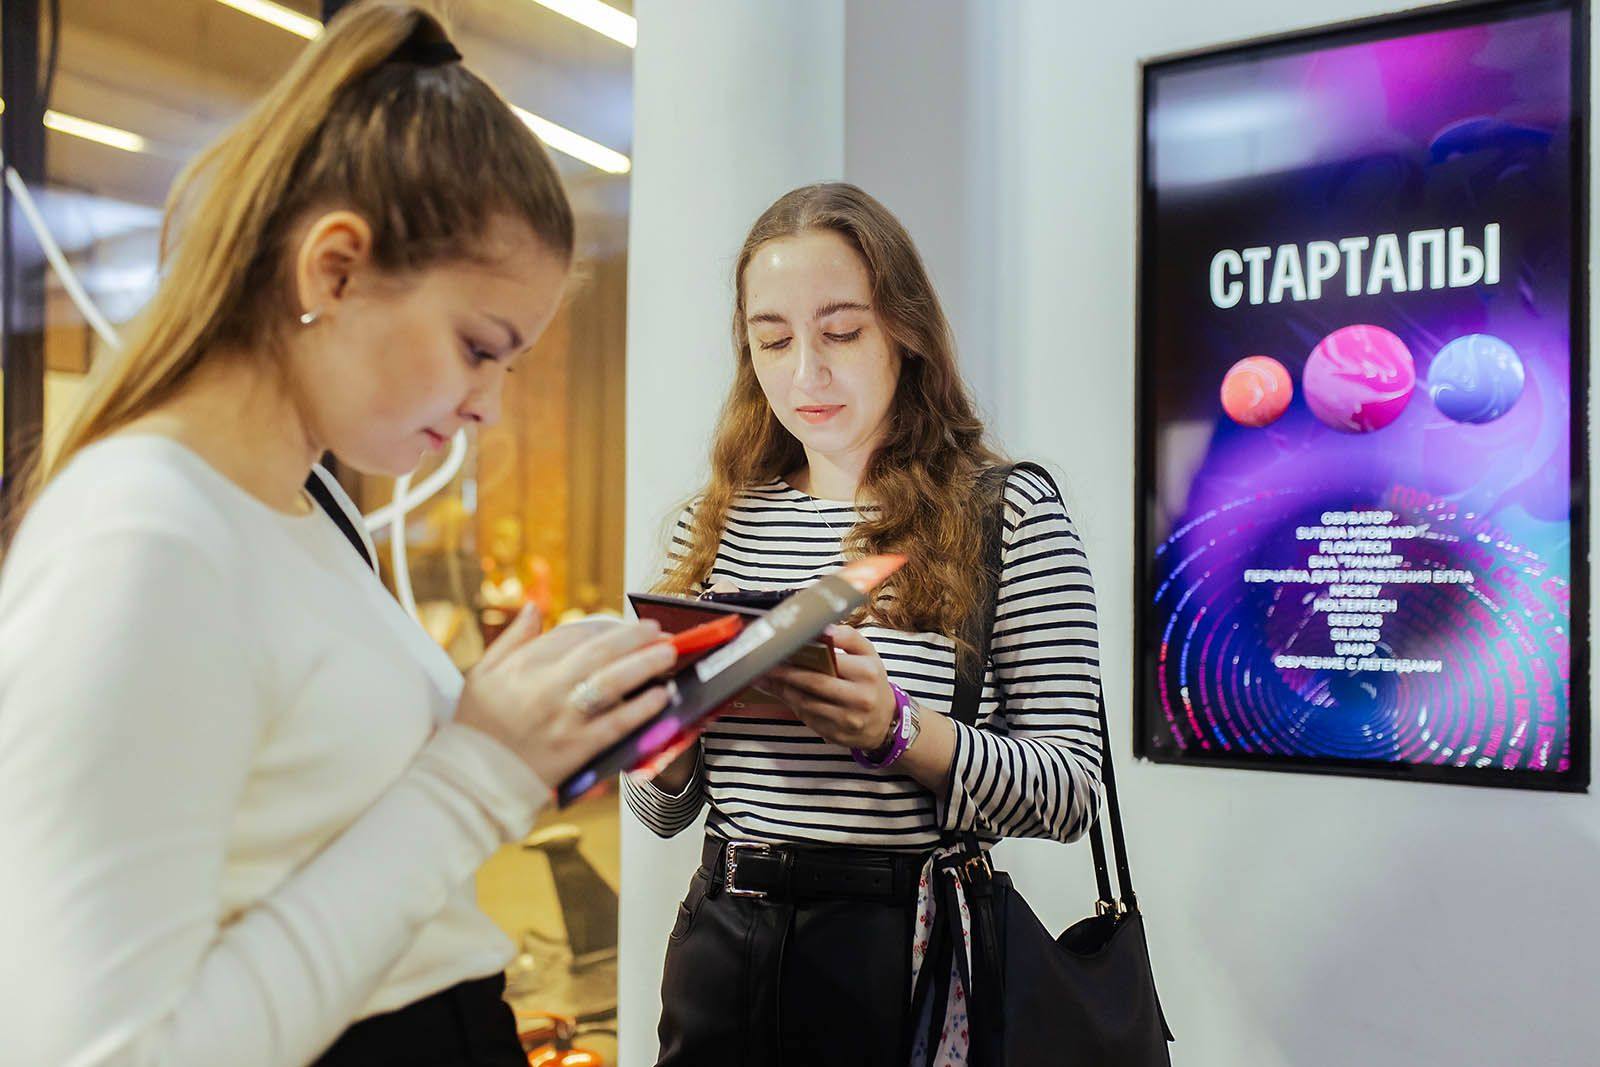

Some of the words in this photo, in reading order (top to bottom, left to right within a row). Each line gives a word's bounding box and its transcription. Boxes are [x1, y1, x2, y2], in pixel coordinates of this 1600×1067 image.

[1209, 222, 1502, 310] СТАРТАПЫ
[1319, 541, 1392, 554] FLOWTECH
[1310, 569, 1340, 584] ДЛЯ
[1340, 569, 1432, 584] УПРАВЛЕНИЯ
[1433, 570, 1475, 584] БПЛА
[1274, 655, 1346, 670] ОБУЧЕНИЕ
[1345, 657, 1358, 671] С
[1357, 658, 1443, 674] ЛЕГЕНДАМИ
